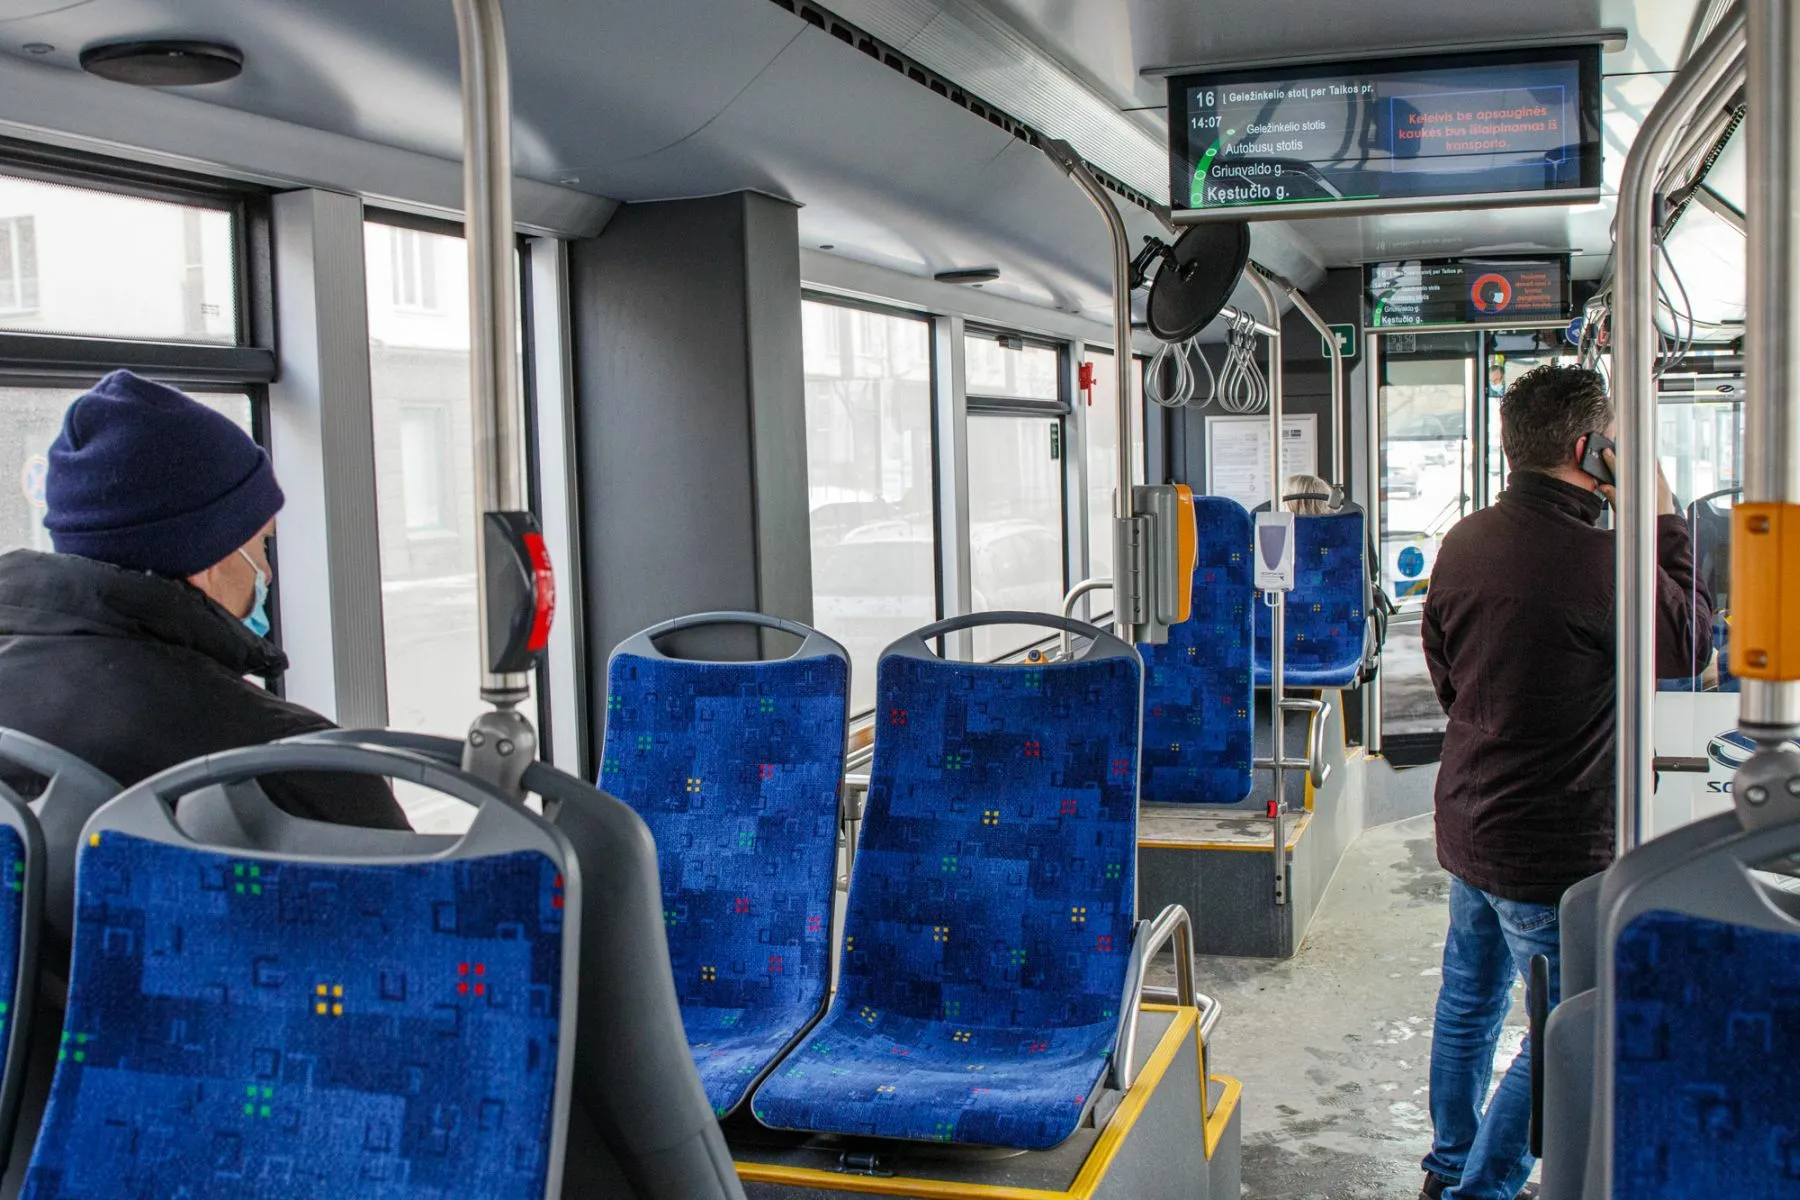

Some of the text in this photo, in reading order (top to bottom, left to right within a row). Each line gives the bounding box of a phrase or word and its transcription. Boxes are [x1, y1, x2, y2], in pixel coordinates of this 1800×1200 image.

[1196, 91, 1215, 107] 16
[1229, 91, 1285, 102] Geležinkelio
[1288, 87, 1309, 100] stotį
[1311, 87, 1326, 100] per
[1329, 84, 1359, 95] Taikos
[1361, 84, 1375, 96] pr.
[1191, 116, 1222, 129] 14:07
[1408, 105, 1548, 125] Keleivis be apsauginės
[1246, 120, 1326, 135] Geležinkelio stotis
[1399, 126, 1442, 139] kaukės
[1445, 125, 1467, 137] bus
[1225, 139, 1303, 155] Autobusų stotis
[1445, 137, 1511, 151] transporto.
[1211, 163, 1285, 178] Griunvaldo g.
[1207, 184, 1290, 204] Kęstučio g.
